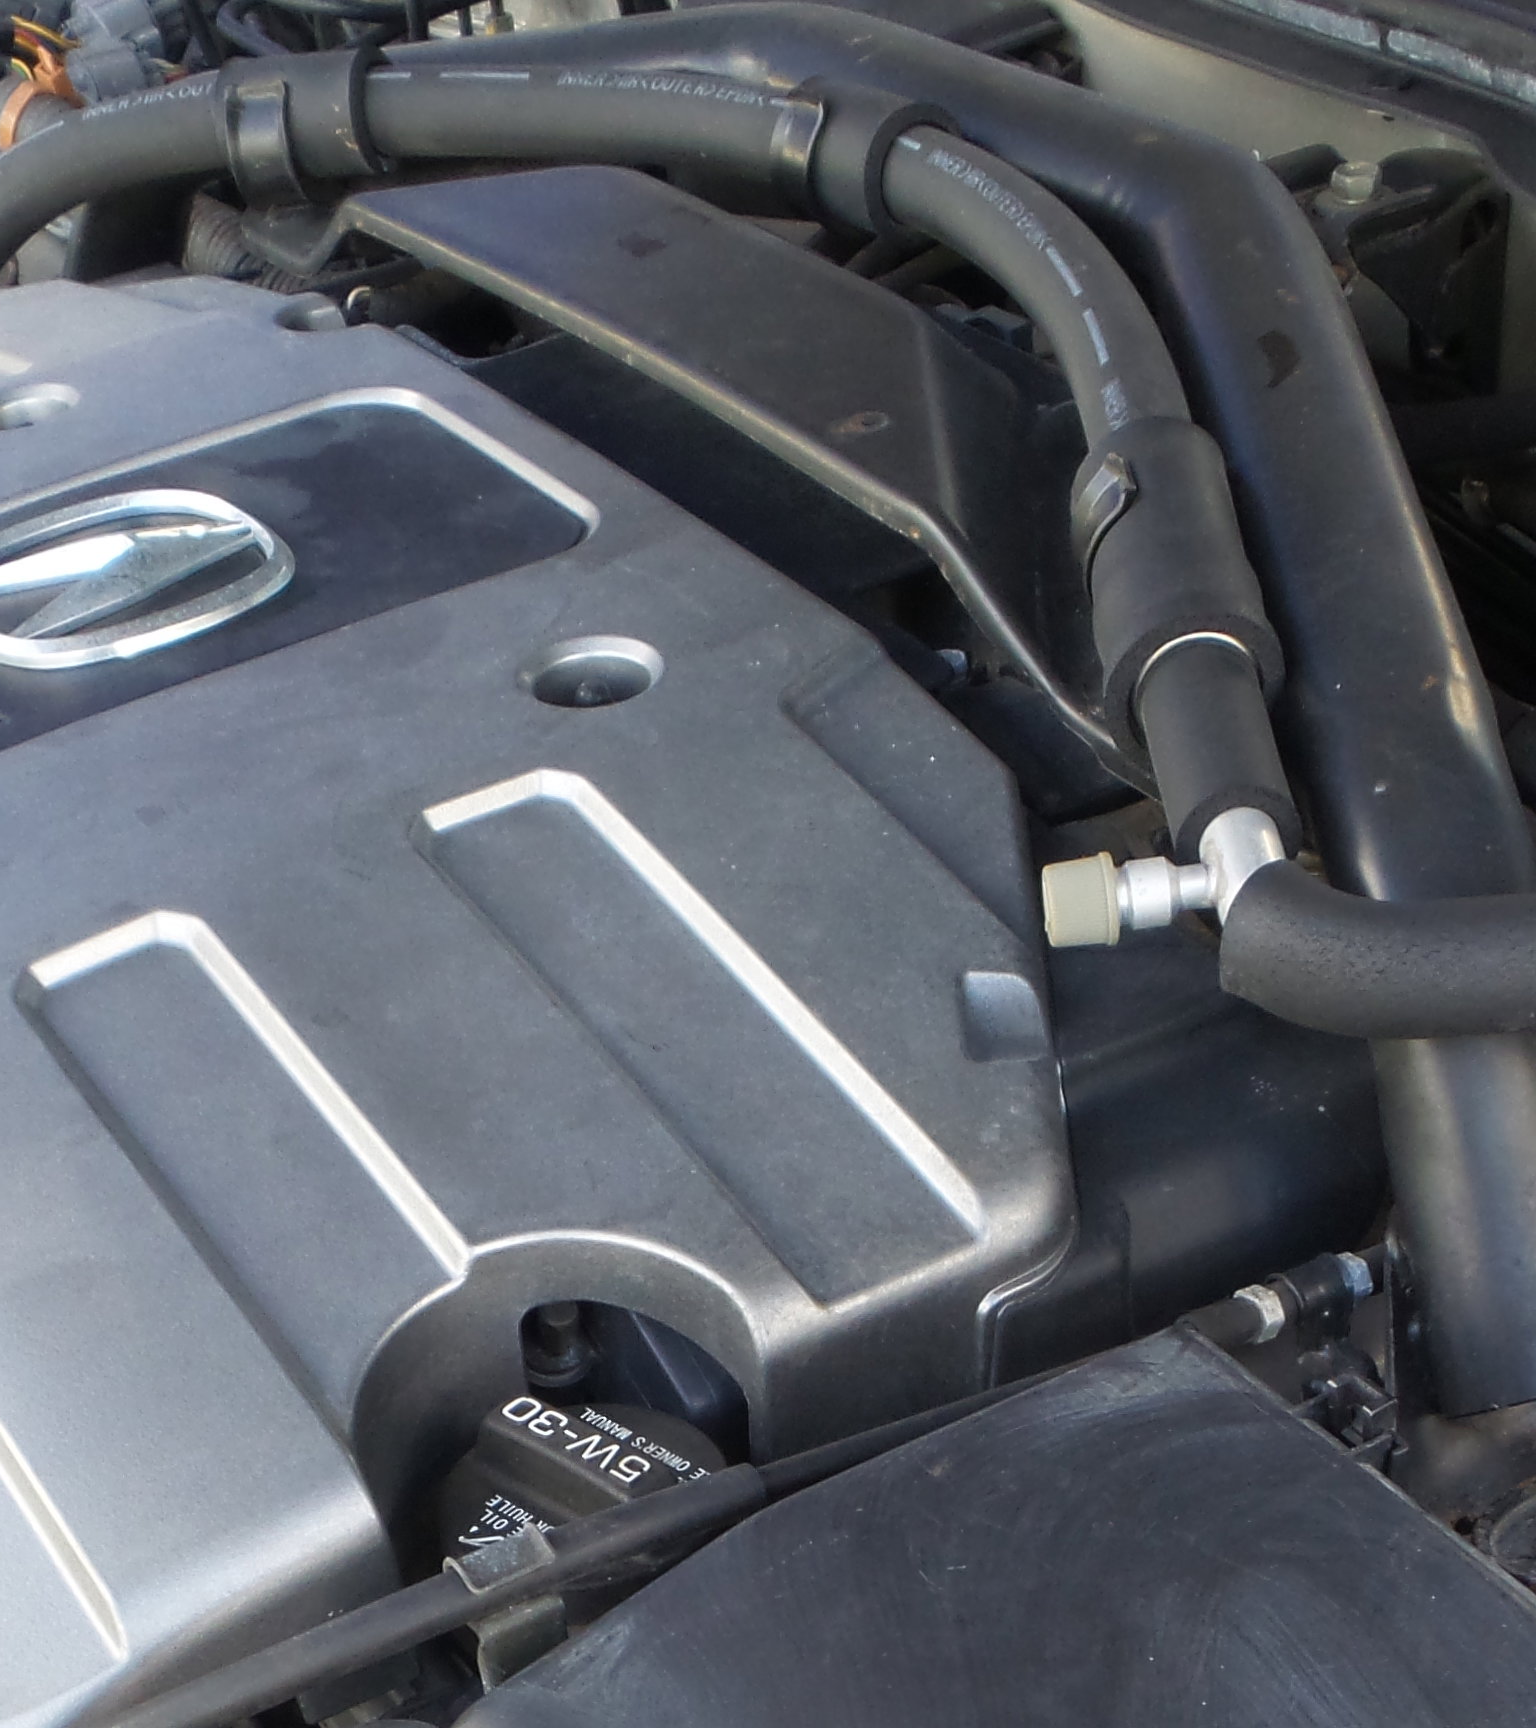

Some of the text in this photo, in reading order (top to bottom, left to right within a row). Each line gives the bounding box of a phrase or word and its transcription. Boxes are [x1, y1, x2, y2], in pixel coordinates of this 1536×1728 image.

[502, 1397, 650, 1482] 5W-30
[581, 1408, 690, 1471] OWNER'S MANUAL
[481, 1509, 508, 1529] OIL
[486, 1495, 533, 1528] HUILE
